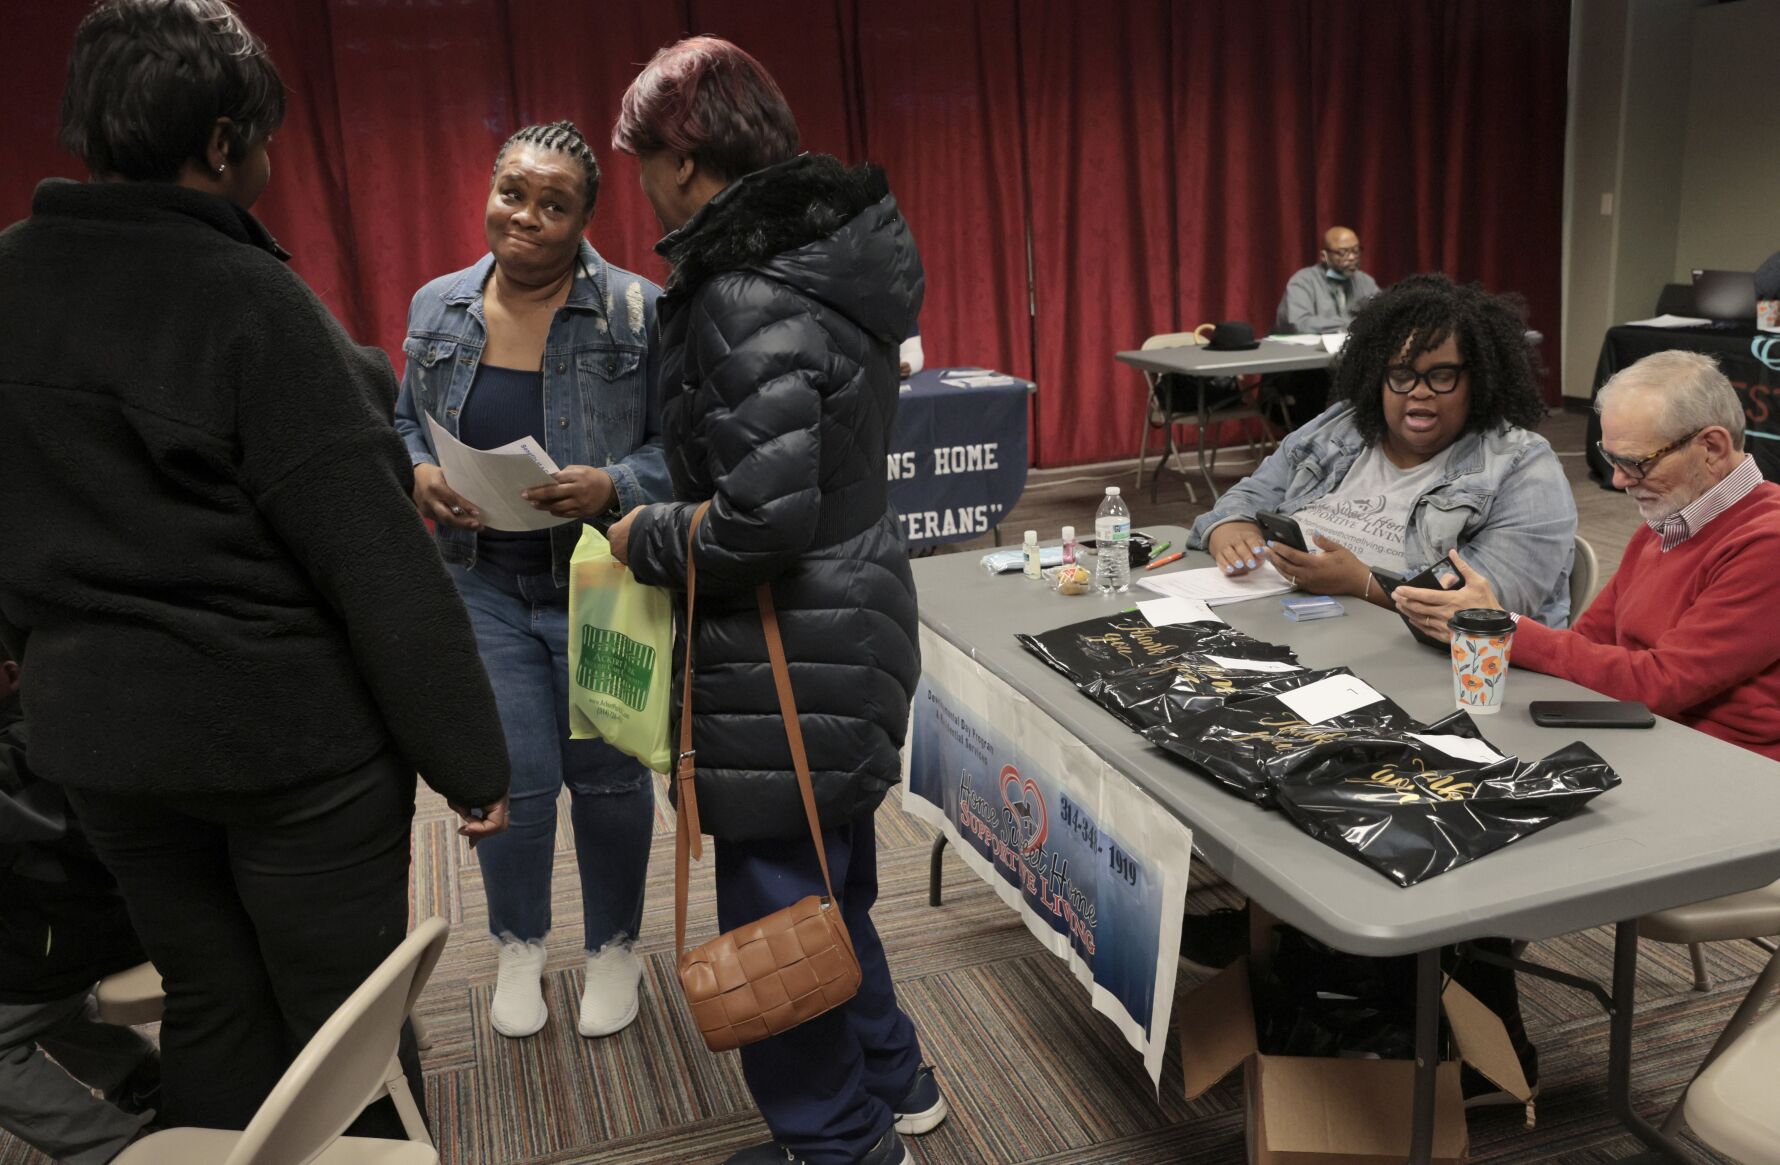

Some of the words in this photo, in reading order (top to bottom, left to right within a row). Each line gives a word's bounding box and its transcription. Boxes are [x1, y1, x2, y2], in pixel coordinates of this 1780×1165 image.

[934, 443, 999, 475] HOME
[1332, 501, 1375, 523] Sweet
[1372, 515, 1405, 532] Hom
[1361, 521, 1405, 544] LIVIN
[959, 768, 999, 828] Home
[959, 799, 1038, 896] SUPPORTVE
[1039, 874, 1097, 955] LIVING
